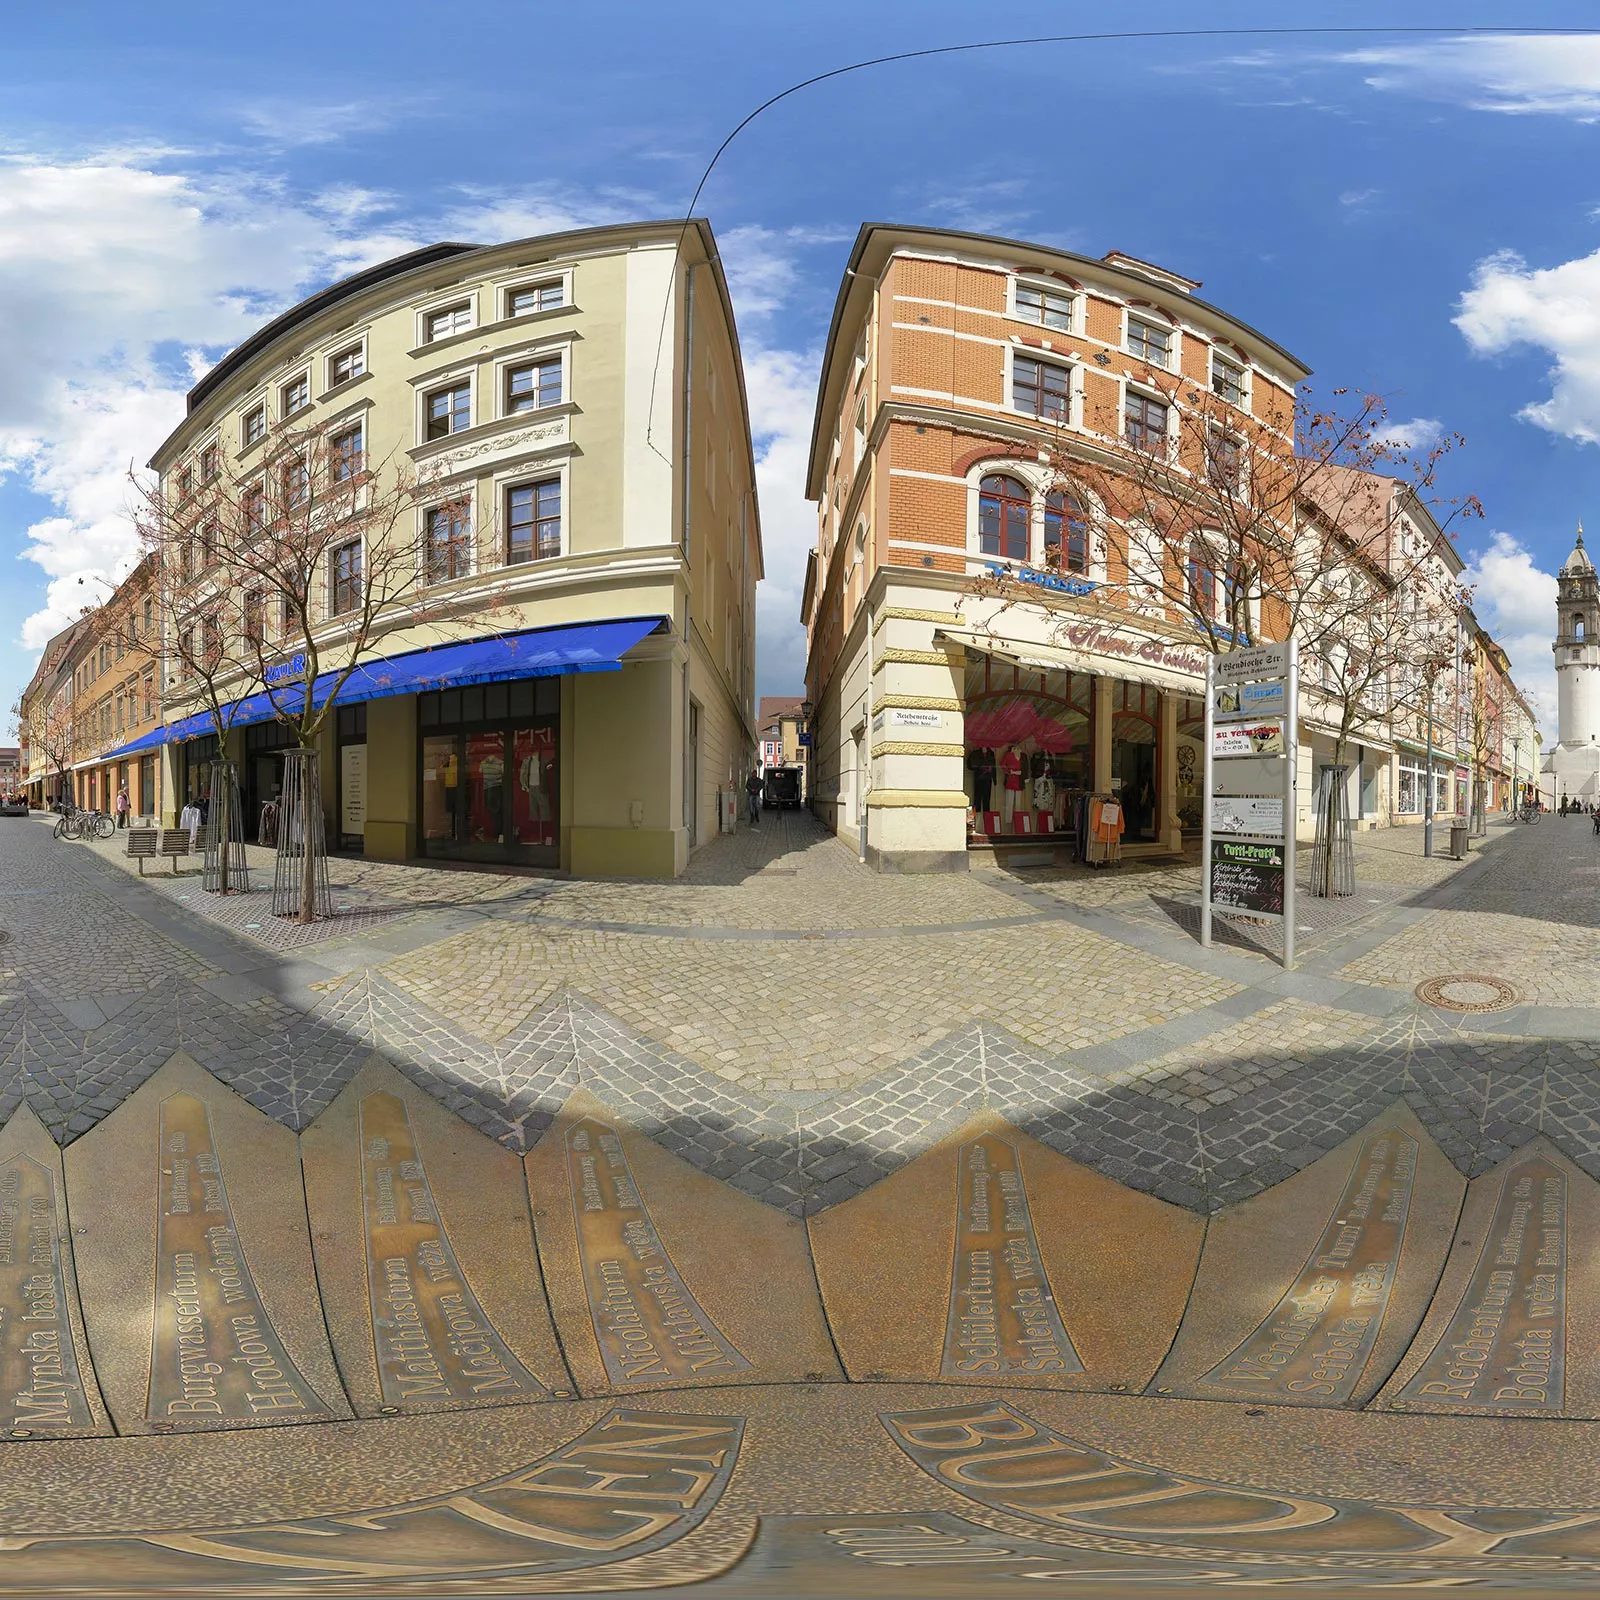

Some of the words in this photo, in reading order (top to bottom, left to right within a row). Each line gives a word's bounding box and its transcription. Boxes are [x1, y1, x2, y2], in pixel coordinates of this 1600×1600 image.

[1223, 657, 1263, 672] Wendische
[1266, 655, 1284, 664] Str.
[1215, 731, 1228, 739] zu
[1223, 843, 1276, 859] Tutti-Frutti
[31, 1226, 52, 1264] Erbaut
[167, 1252, 225, 1416] Burgwasserturm
[383, 1257, 452, 1400] Matthiasturm
[599, 1259, 672, 1380] Nicolaiturm
[955, 1250, 1002, 1372] Schülerturm
[1220, 1275, 1341, 1382] Wendischer
[1315, 1224, 1361, 1269] Turm
[1417, 1270, 1514, 1400] Reichenturm
[231, 1315, 307, 1413] Hrodowa
[1286, 1316, 1371, 1396] Serbska
[1494, 1329, 1553, 1403] Bohata
